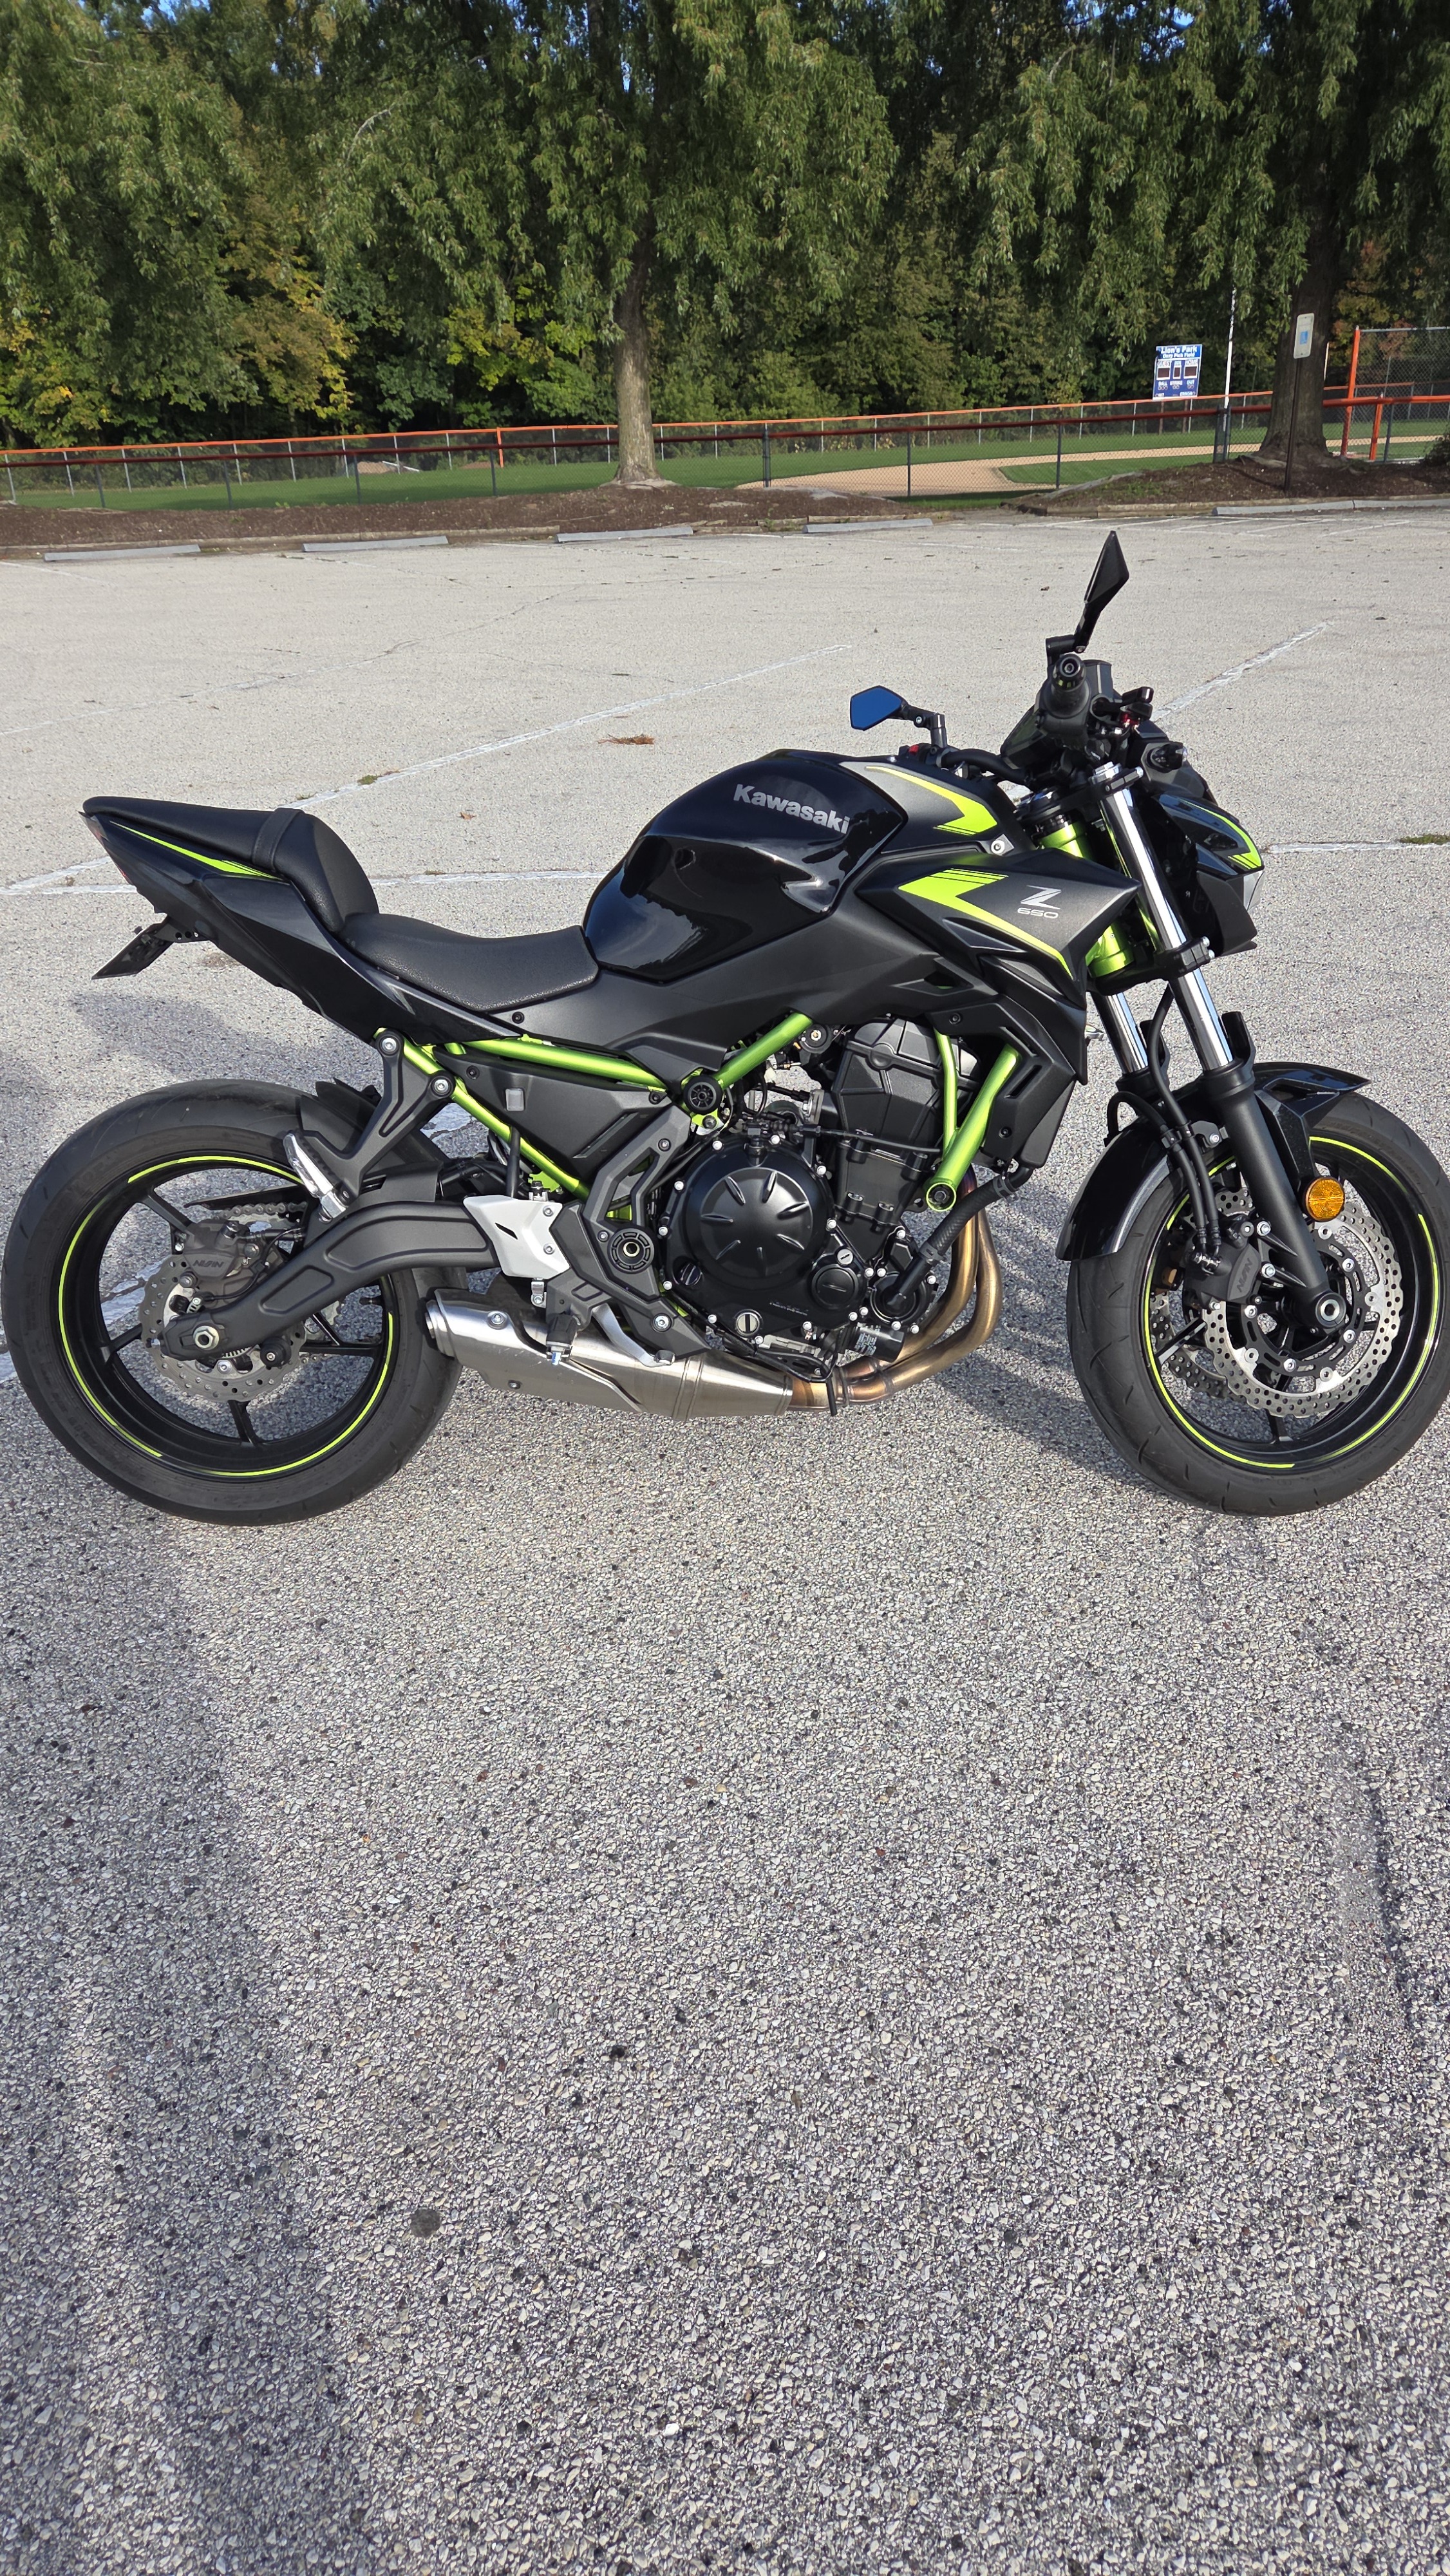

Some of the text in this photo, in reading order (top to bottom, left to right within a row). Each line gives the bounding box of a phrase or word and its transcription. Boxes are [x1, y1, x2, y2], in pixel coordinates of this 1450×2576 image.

[1161, 346, 1180, 354] Lion's
[733, 784, 851, 835] Kawasaki
[1020, 884, 1062, 910] Z
[1017, 907, 1059, 919] 650
